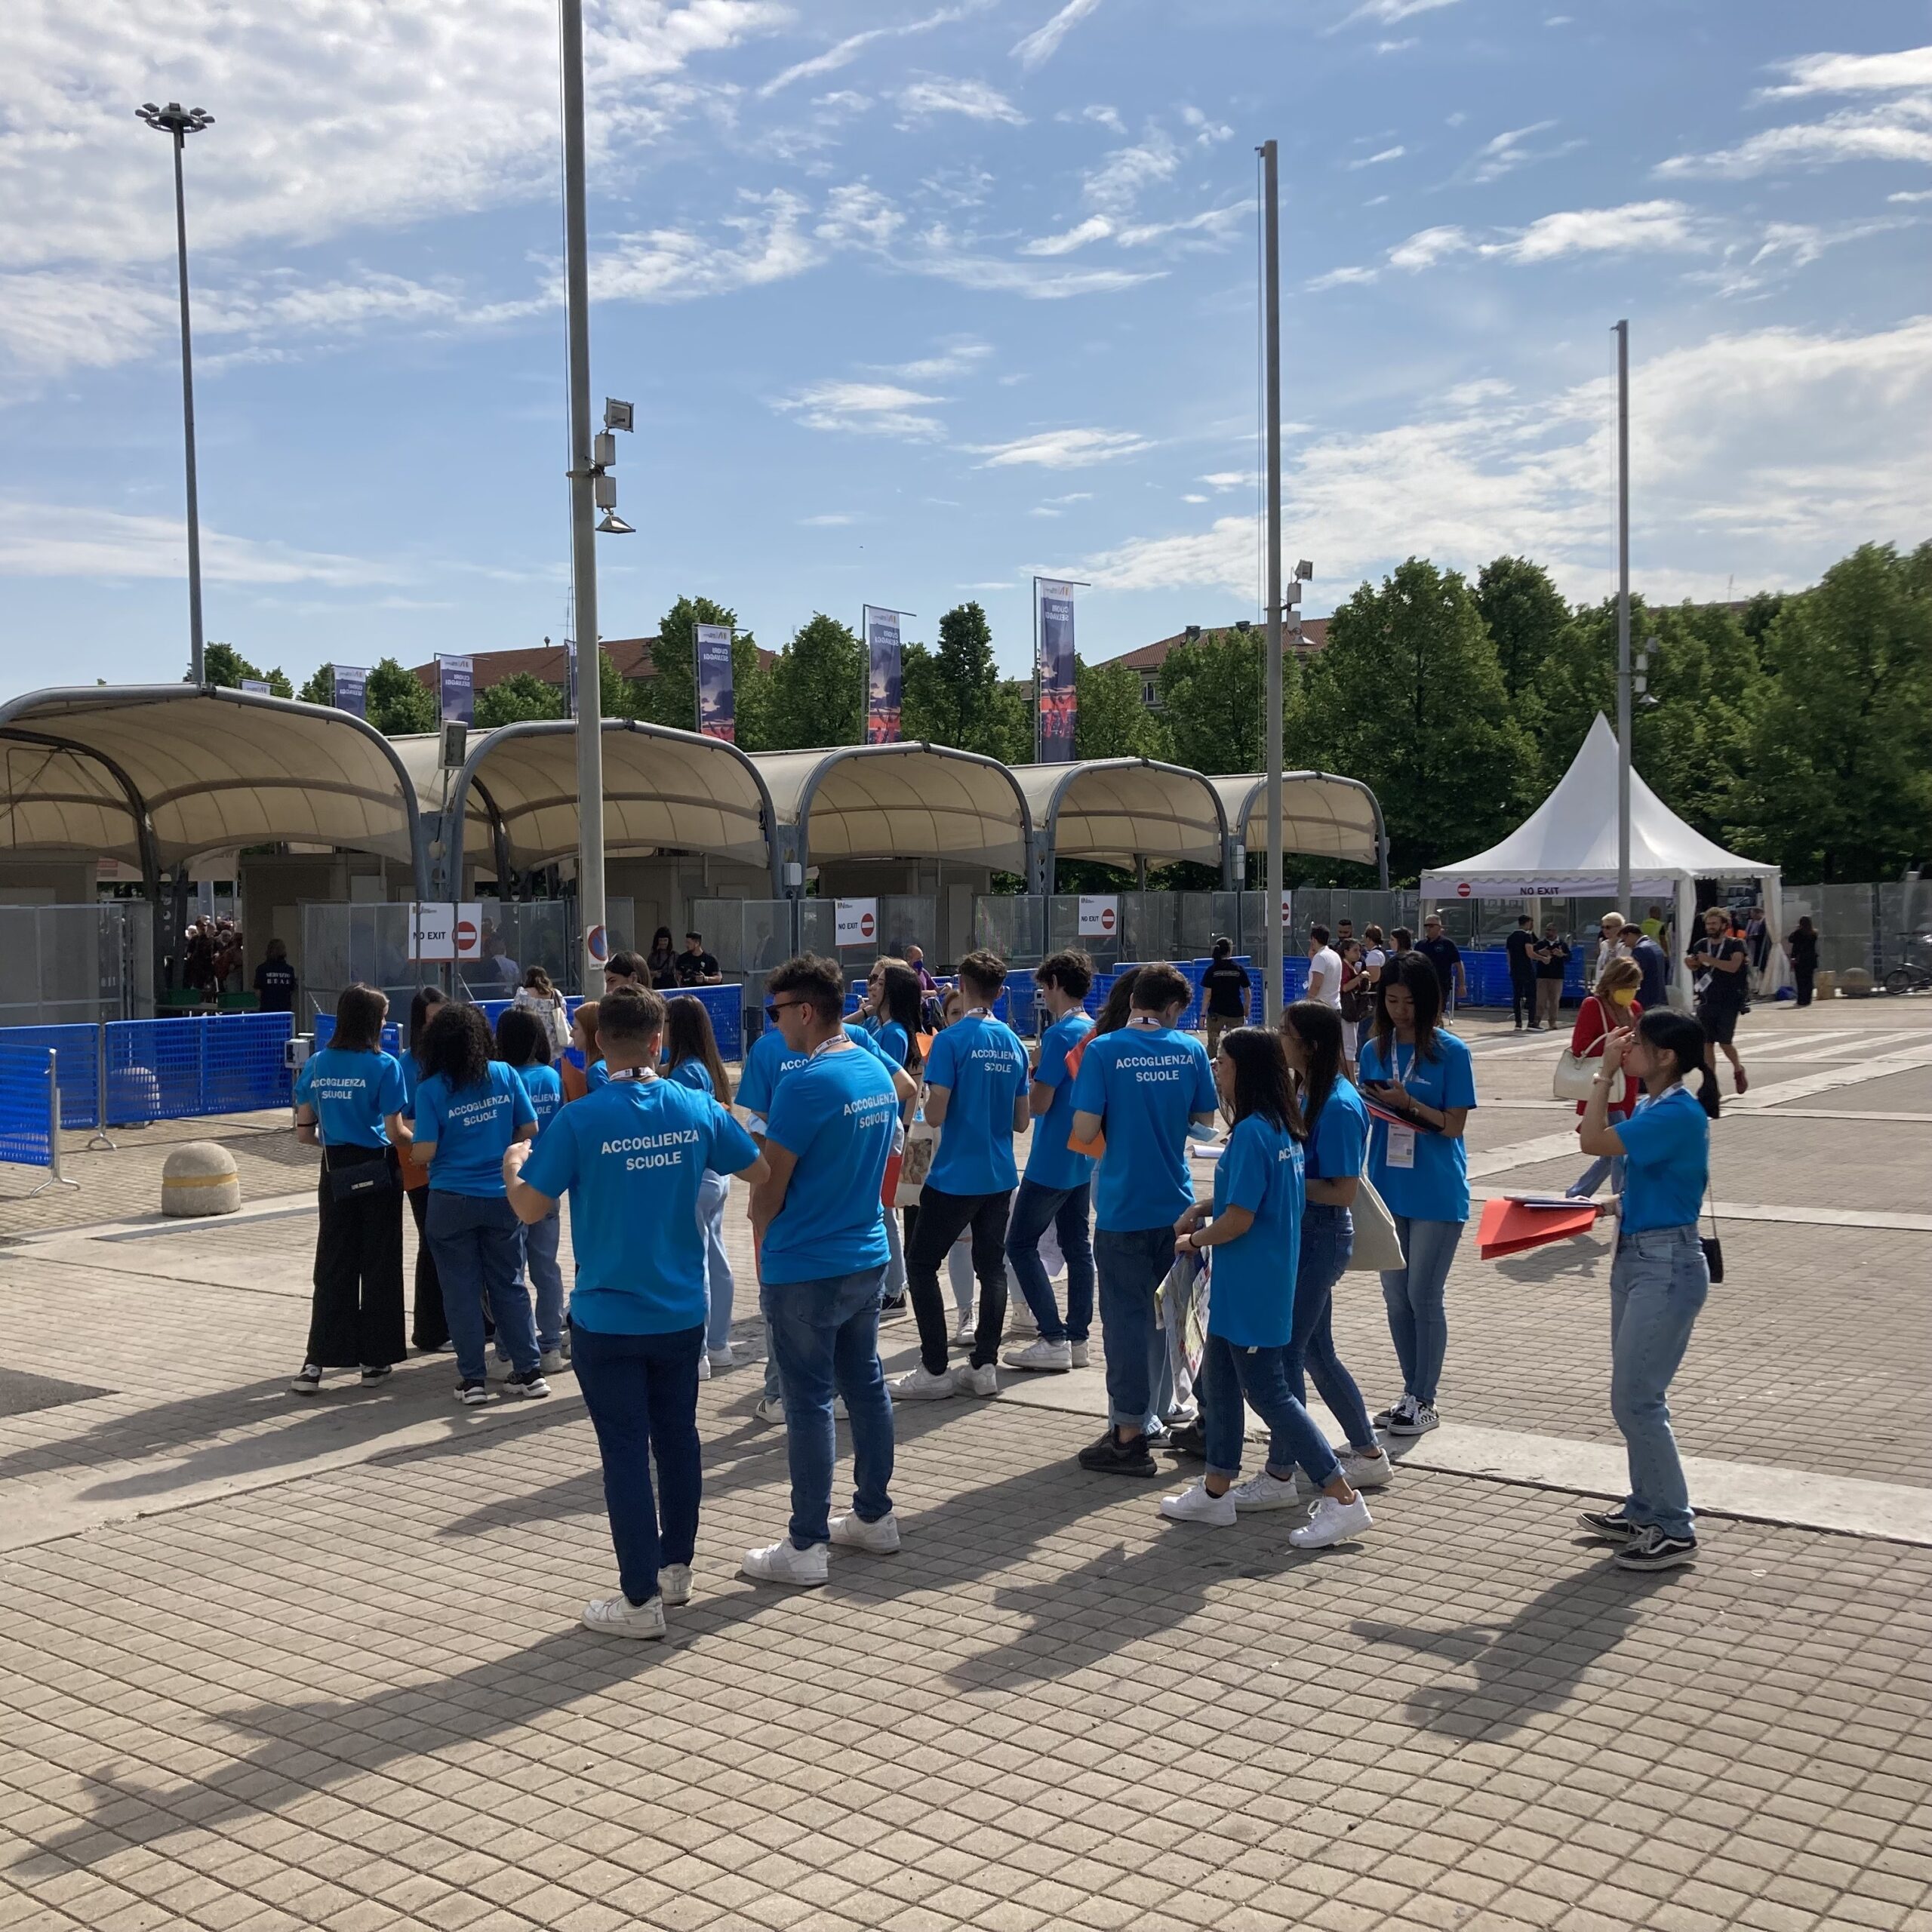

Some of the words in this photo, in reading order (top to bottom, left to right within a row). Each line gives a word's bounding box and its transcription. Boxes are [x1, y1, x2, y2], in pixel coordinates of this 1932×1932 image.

[1520, 887, 1534, 895] NO
[1537, 887, 1559, 895] EXIT
[427, 931, 447, 940] EXIT
[971, 1049, 1019, 1061] ACCOGLIEN
[1115, 1054, 1194, 1069] ACCOGLIENZA
[310, 1078, 366, 1088] ACCOGLIENZA
[1136, 1070, 1180, 1082] SCUOLE
[321, 1091, 352, 1100] SCUOLE
[448, 1094, 511, 1118] ACCOGLIENZA
[843, 1091, 897, 1116] ACCOGLIENZ
[463, 1109, 498, 1126] SCUOLE
[860, 1110, 890, 1129] SCUOLE
[601, 1129, 700, 1155] ACCOGLIENZA
[626, 1151, 682, 1171] SCUOLE
